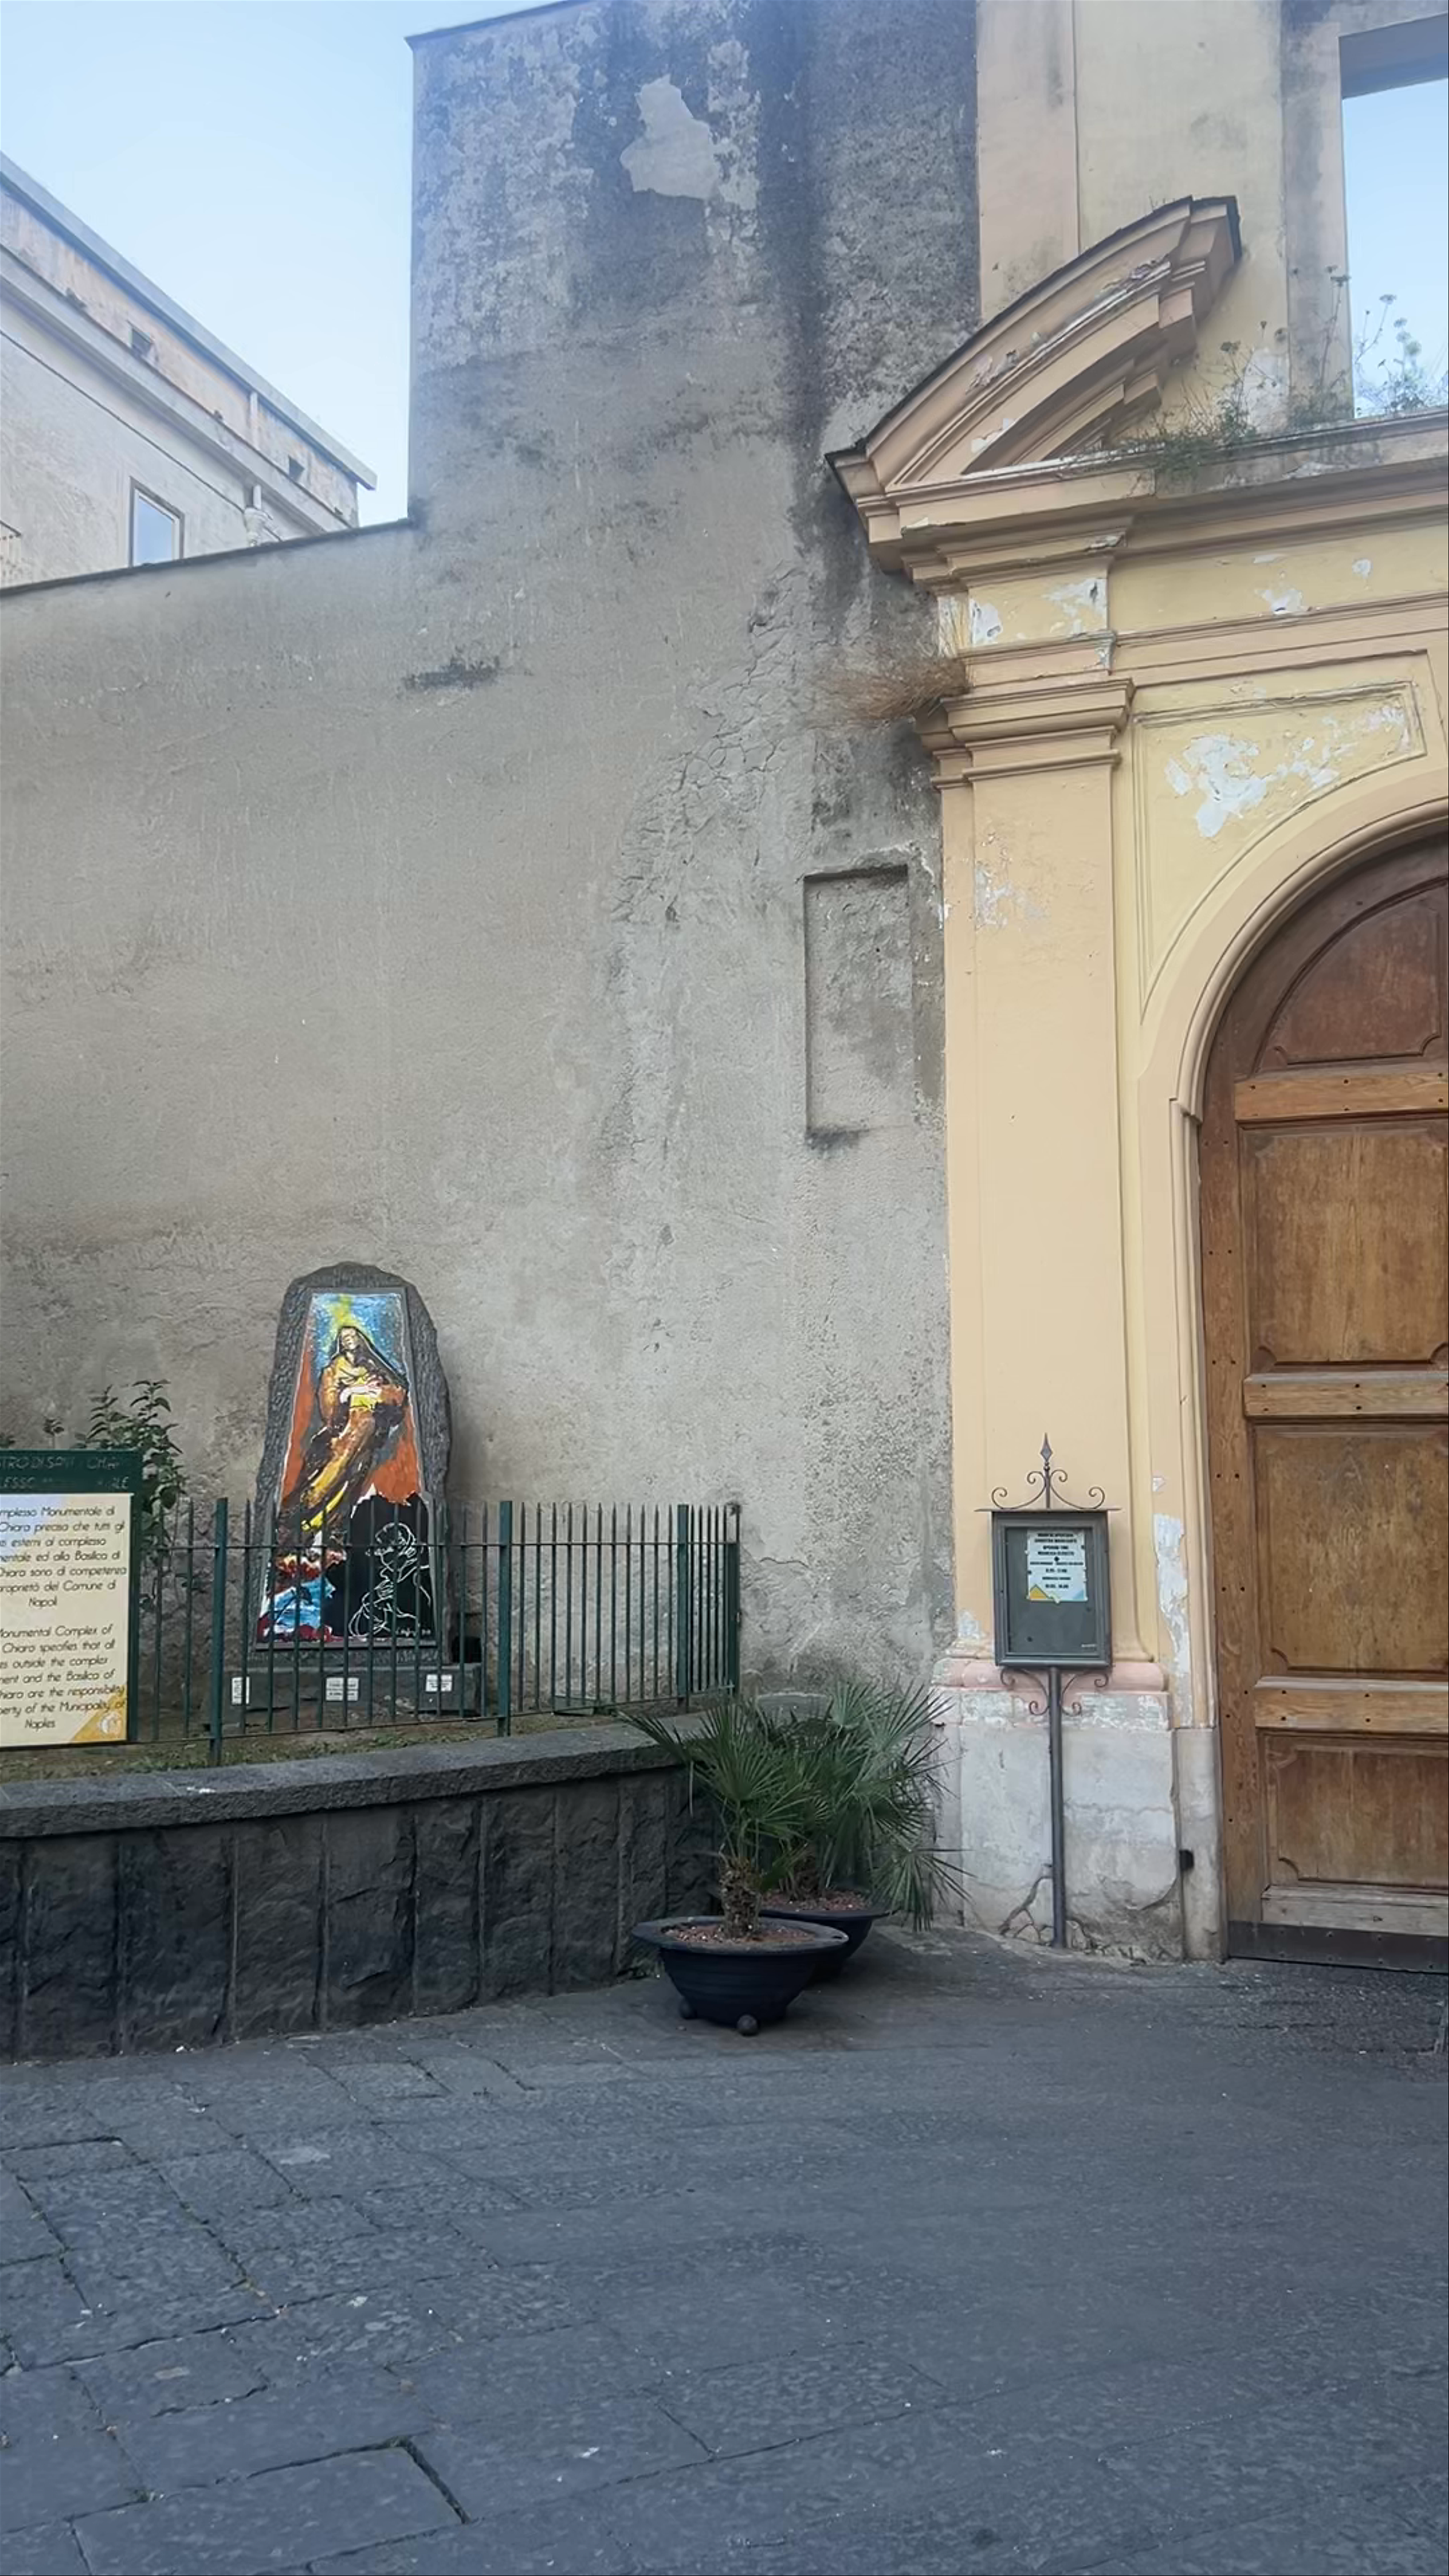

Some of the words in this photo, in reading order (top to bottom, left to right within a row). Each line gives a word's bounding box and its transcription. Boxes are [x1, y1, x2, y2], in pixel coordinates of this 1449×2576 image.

[0, 1456, 30, 1469] TRO
[41, 1506, 102, 1516] Monumentale
[73, 1522, 90, 1531] che
[58, 1536, 106, 1548] complesso
[35, 1551, 50, 1561] ed
[53, 1551, 70, 1561] alla
[74, 1550, 108, 1561] Basilica
[30, 1569, 52, 1577] sono
[69, 1567, 127, 1578] competenza
[43, 1581, 60, 1592] del
[62, 1579, 103, 1591] Comune
[28, 1596, 57, 1608] Napoli
[0, 1626, 52, 1638] onumental
[55, 1625, 98, 1639] Complex
[102, 1623, 114, 1635] of
[2, 1642, 35, 1653] Chiara
[83, 1642, 101, 1650] that
[12, 1657, 46, 1669] outside
[51, 1656, 65, 1667] the
[69, 1655, 109, 1668] complex
[23, 1674, 43, 1683] and
[47, 1672, 62, 1682] the
[66, 1670, 100, 1681] Basilica
[103, 1668, 116, 1679] of
[28, 1690, 45, 1698] are
[49, 1687, 64, 1697] the
[68, 1684, 126, 1698] responsibility
[25, 1702, 38, 1714] of
[41, 1702, 56, 1712] the
[60, 1699, 110, 1714] Municipality
[25, 1718, 56, 1732] Naples
